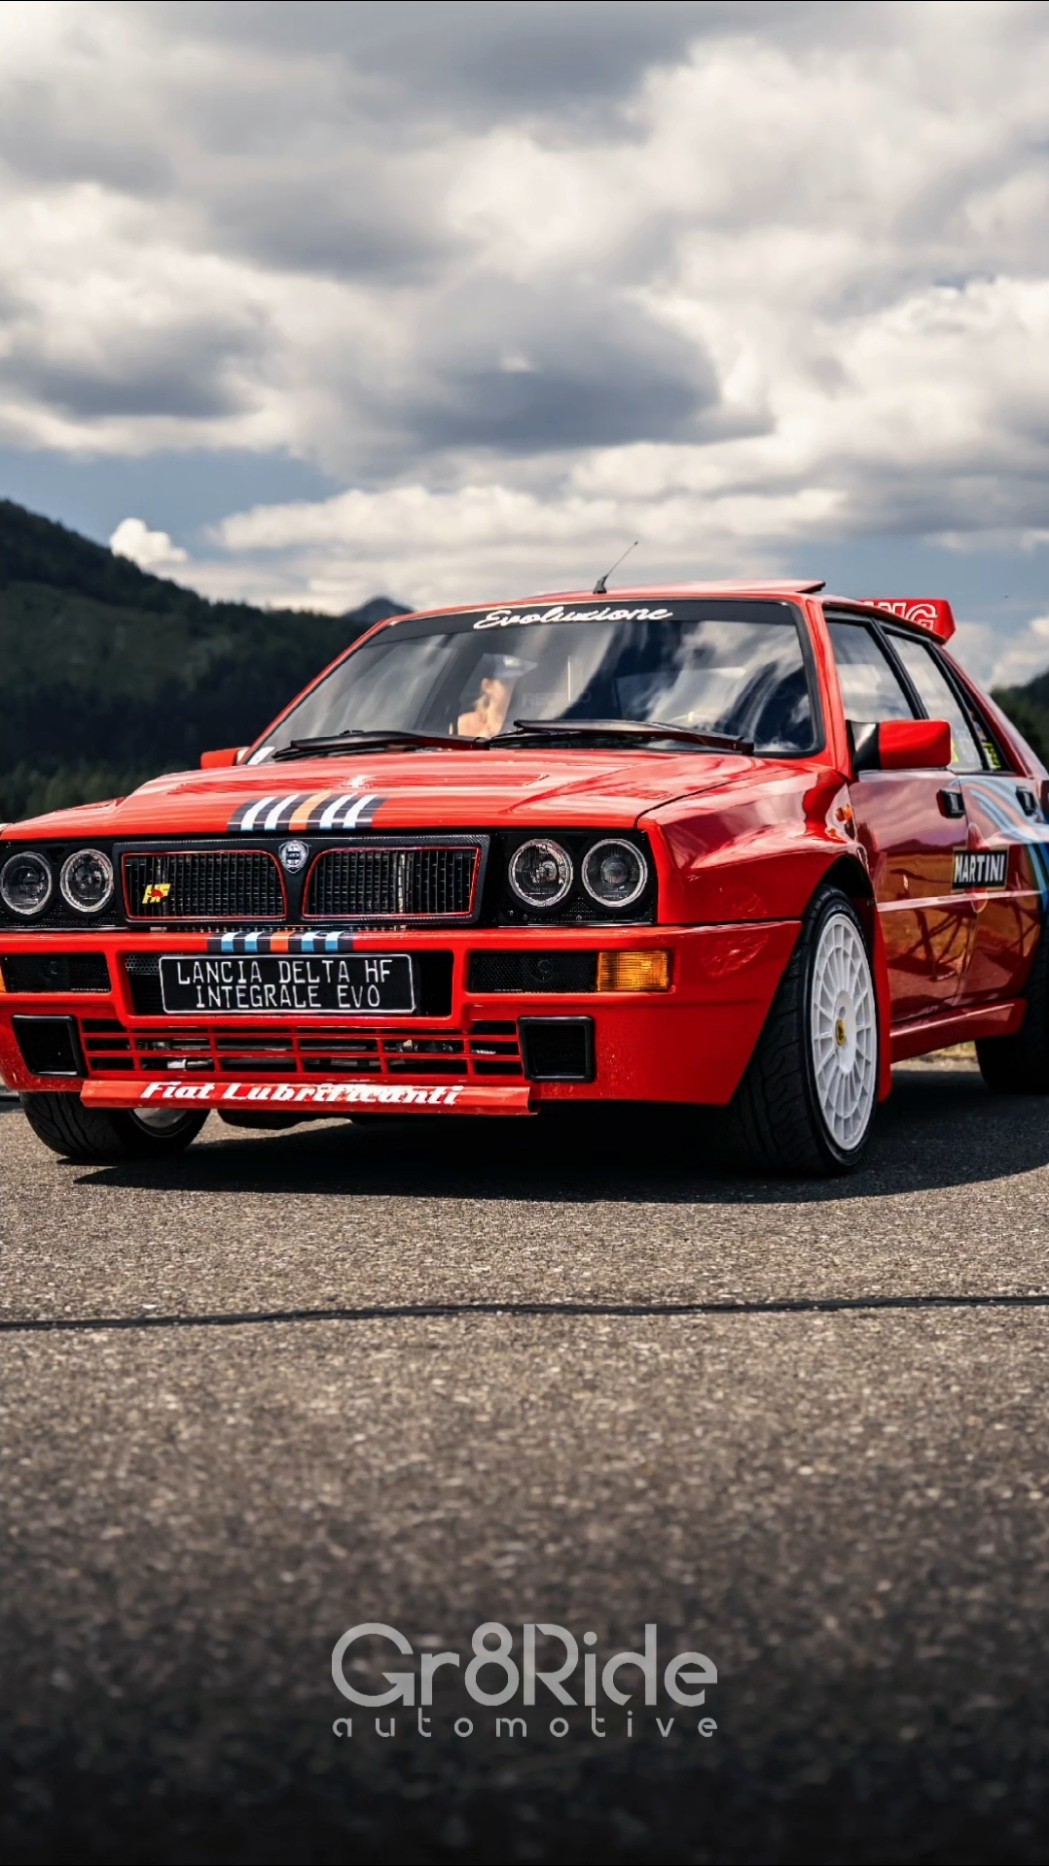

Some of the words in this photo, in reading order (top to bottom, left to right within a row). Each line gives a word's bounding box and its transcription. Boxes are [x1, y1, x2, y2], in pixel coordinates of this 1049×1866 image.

[473, 606, 674, 629] Evoluzione
[953, 853, 1005, 884] MARTINI
[177, 960, 263, 985] LANCIA
[278, 959, 350, 984] DELTA
[365, 959, 393, 983] HF
[196, 984, 322, 1009] INTEGRALE
[337, 984, 381, 1008] EVO
[140, 1081, 216, 1100] Fiat
[222, 1083, 465, 1105] Lubrificanti
